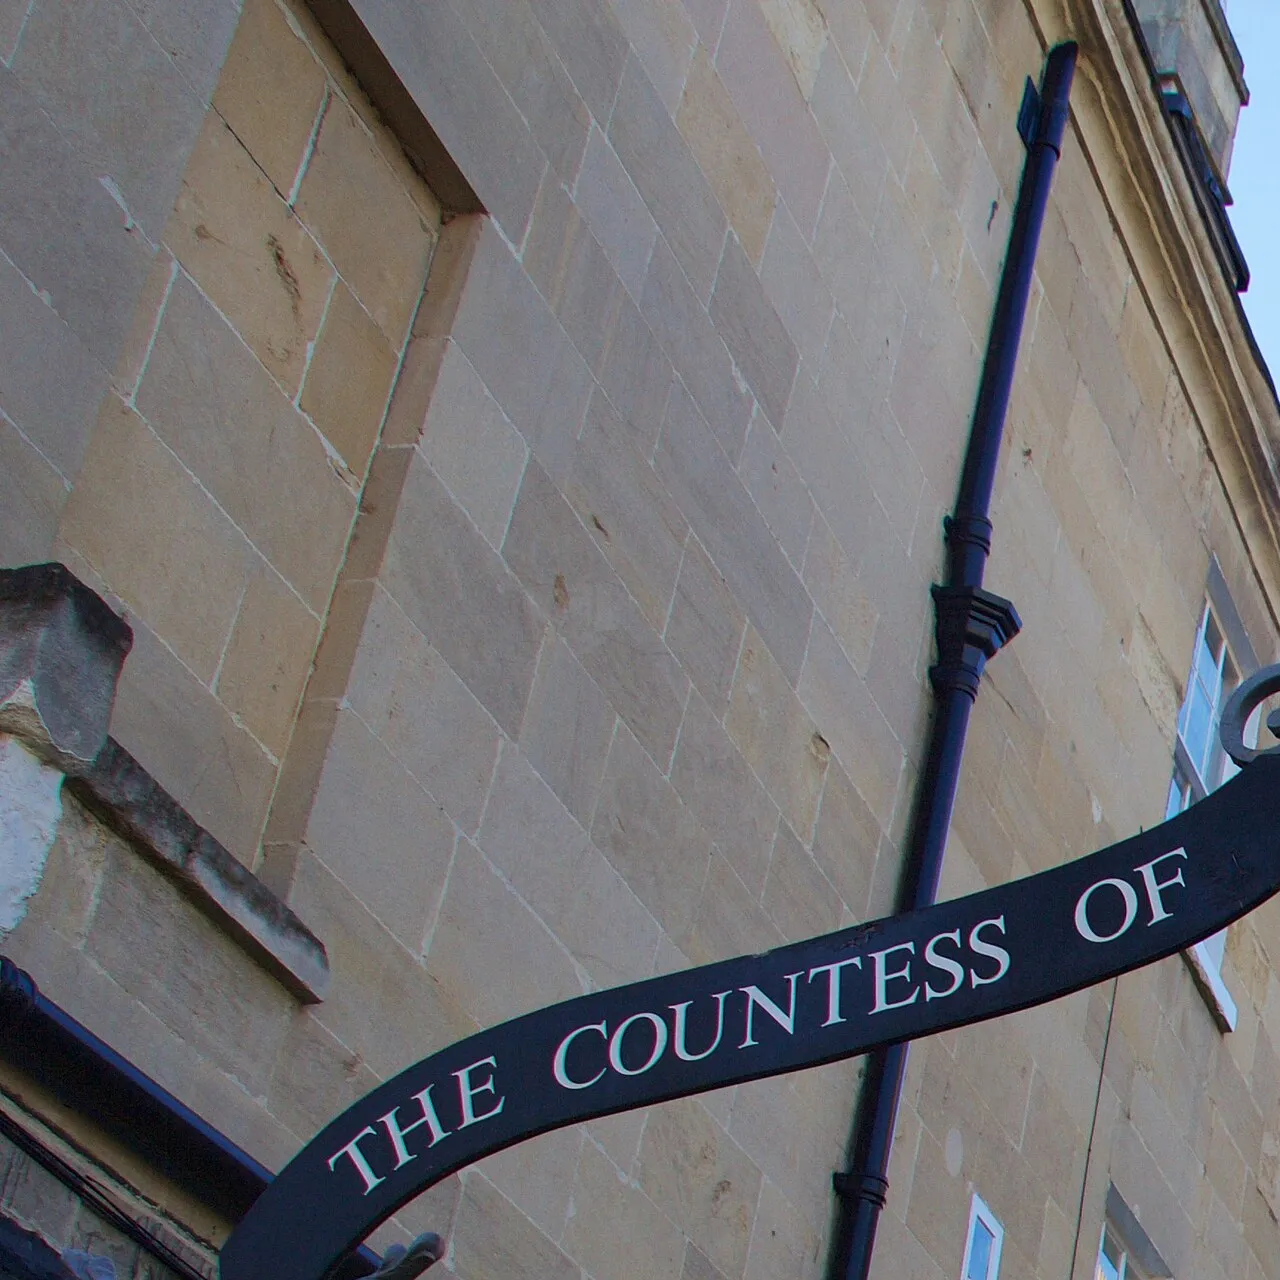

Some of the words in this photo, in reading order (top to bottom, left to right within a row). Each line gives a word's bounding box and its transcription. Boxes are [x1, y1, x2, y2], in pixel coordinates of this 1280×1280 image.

[326, 1054, 506, 1197] THE
[553, 914, 1012, 1091] COUNTESS
[1073, 846, 1191, 944] OF
